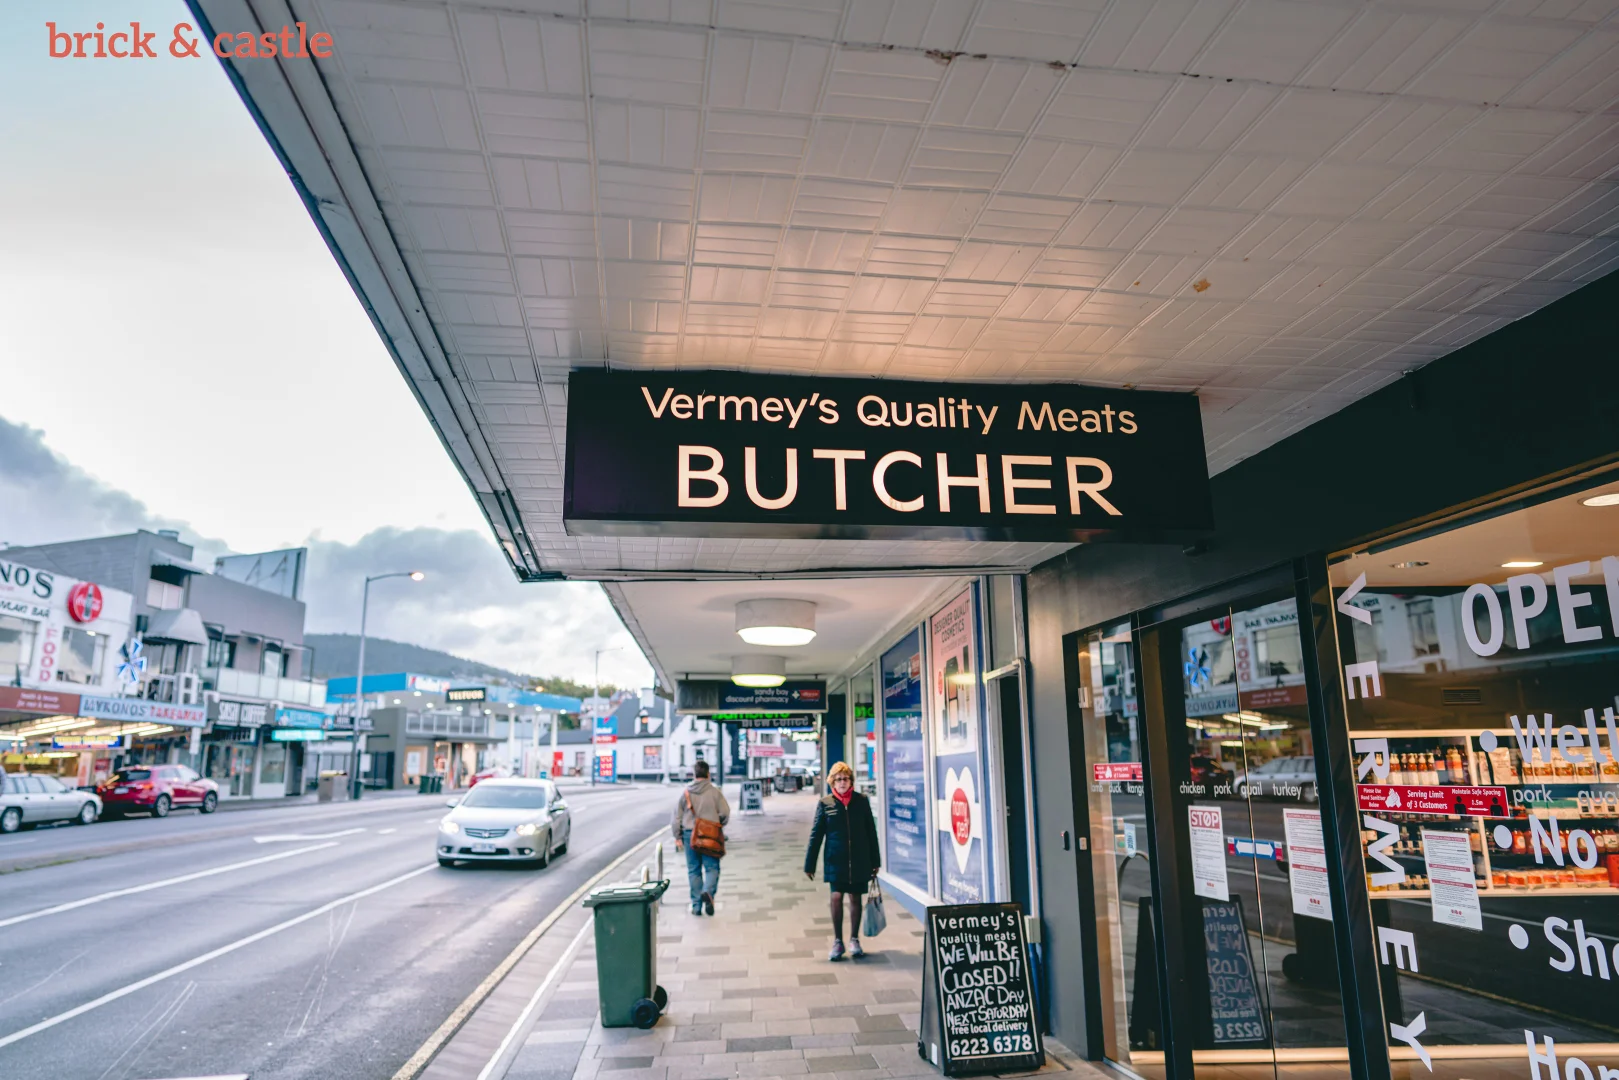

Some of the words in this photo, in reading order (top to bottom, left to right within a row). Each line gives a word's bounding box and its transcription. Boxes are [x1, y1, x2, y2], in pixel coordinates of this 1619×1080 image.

[641, 386, 839, 429] Vermey's
[857, 395, 998, 434] Quality
[1017, 401, 1138, 434] Meats
[677, 445, 1123, 516] BUTCHER
[39, 628, 58, 682] FOOD
[725, 695, 754, 703] discount
[755, 696, 789, 704] pharmacy
[754, 688, 774, 696] sandy
[83, 698, 147, 716] MYKONOS
[150, 705, 204, 722] TAKEAWAY
[1510, 696, 1619, 764] Well
[1109, 782, 1122, 793] duck
[1180, 782, 1206, 795] chicken
[1214, 782, 1232, 797] pork
[1241, 782, 1263, 798] quail
[1273, 782, 1302, 799] turkey
[1407, 789, 1428, 799] Serving
[1428, 790, 1444, 799] Limit
[1471, 788, 1482, 796] Safe
[1482, 788, 1502, 797] Spacing
[1512, 782, 1554, 807] pork
[1406, 800, 1413, 809] of
[1419, 800, 1448, 810] Customers
[1191, 810, 1219, 827] STOP
[1528, 814, 1598, 870] No
[938, 912, 1015, 930] vermey's
[940, 932, 980, 947] quality
[984, 931, 1017, 942] meats
[1543, 916, 1619, 980] Sh
[951, 1025, 970, 1035] free
[970, 1022, 992, 1034] local
[993, 1021, 1028, 1033] delivery
[950, 1038, 990, 1057] 6223
[993, 1034, 1033, 1053] 6378
